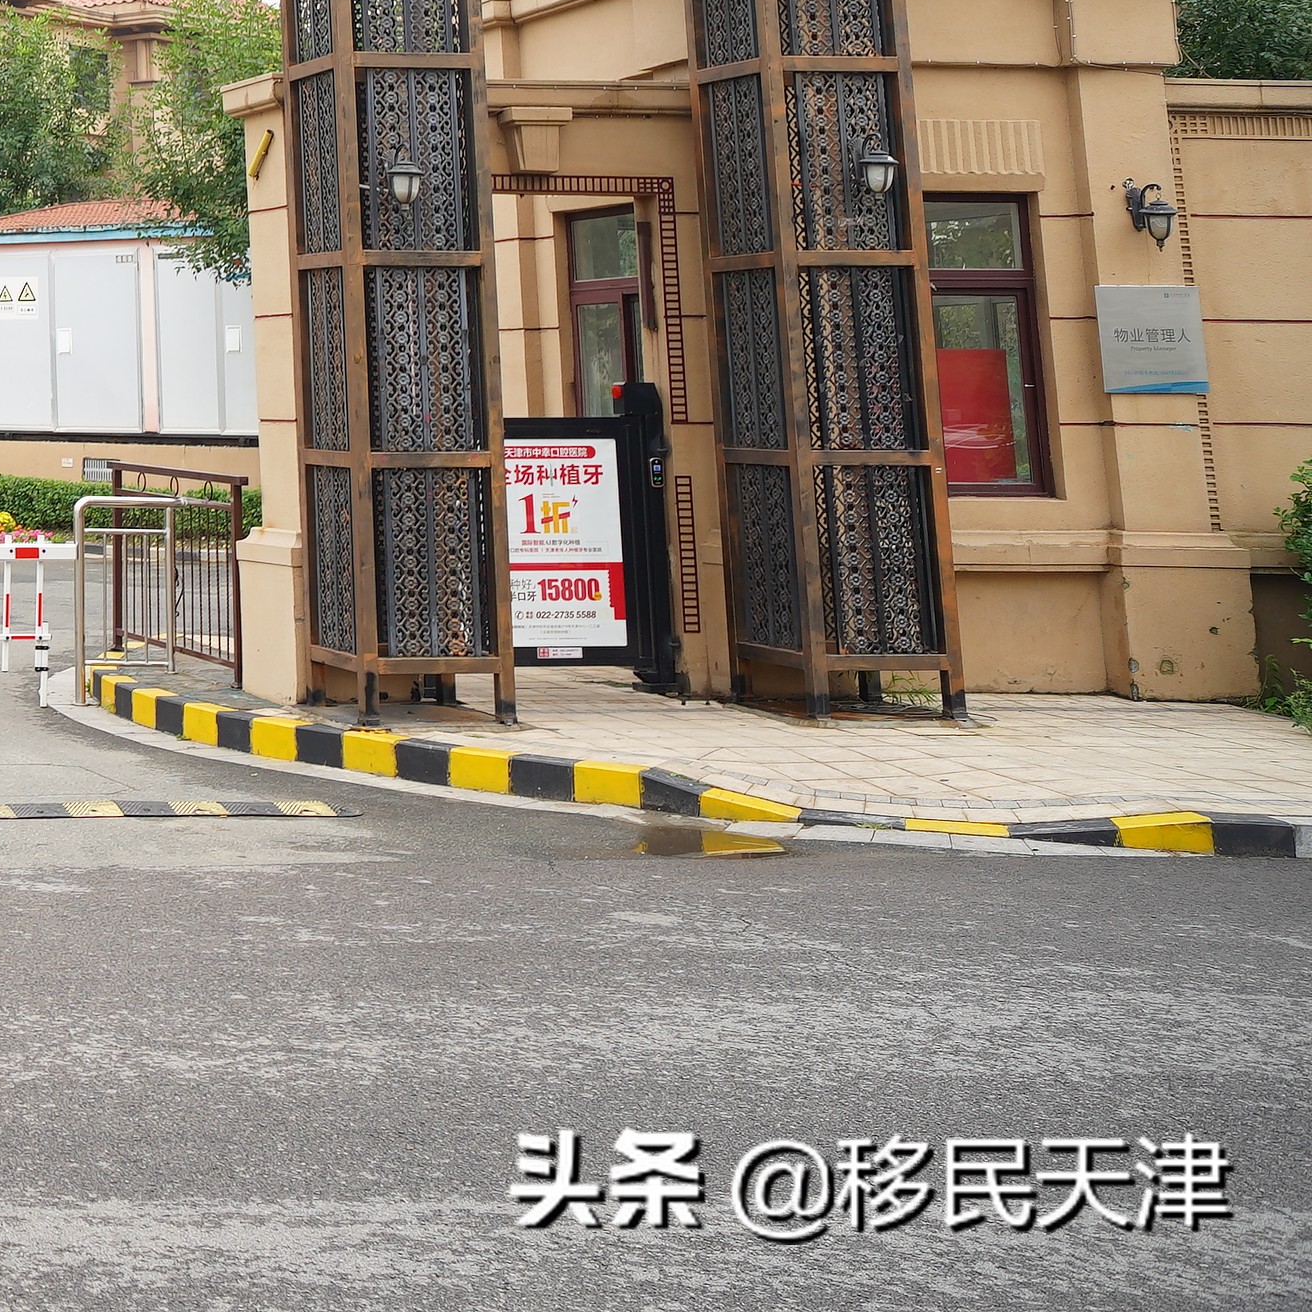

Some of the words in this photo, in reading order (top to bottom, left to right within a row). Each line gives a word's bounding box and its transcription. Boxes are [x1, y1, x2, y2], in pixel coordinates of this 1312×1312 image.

[1114, 328, 1191, 342] 物业管理人
[505, 464, 603, 486] 场种植牙
[537, 578, 600, 601] 15800
[536, 611, 575, 619] 022-2735
[576, 611, 597, 619] 5588
